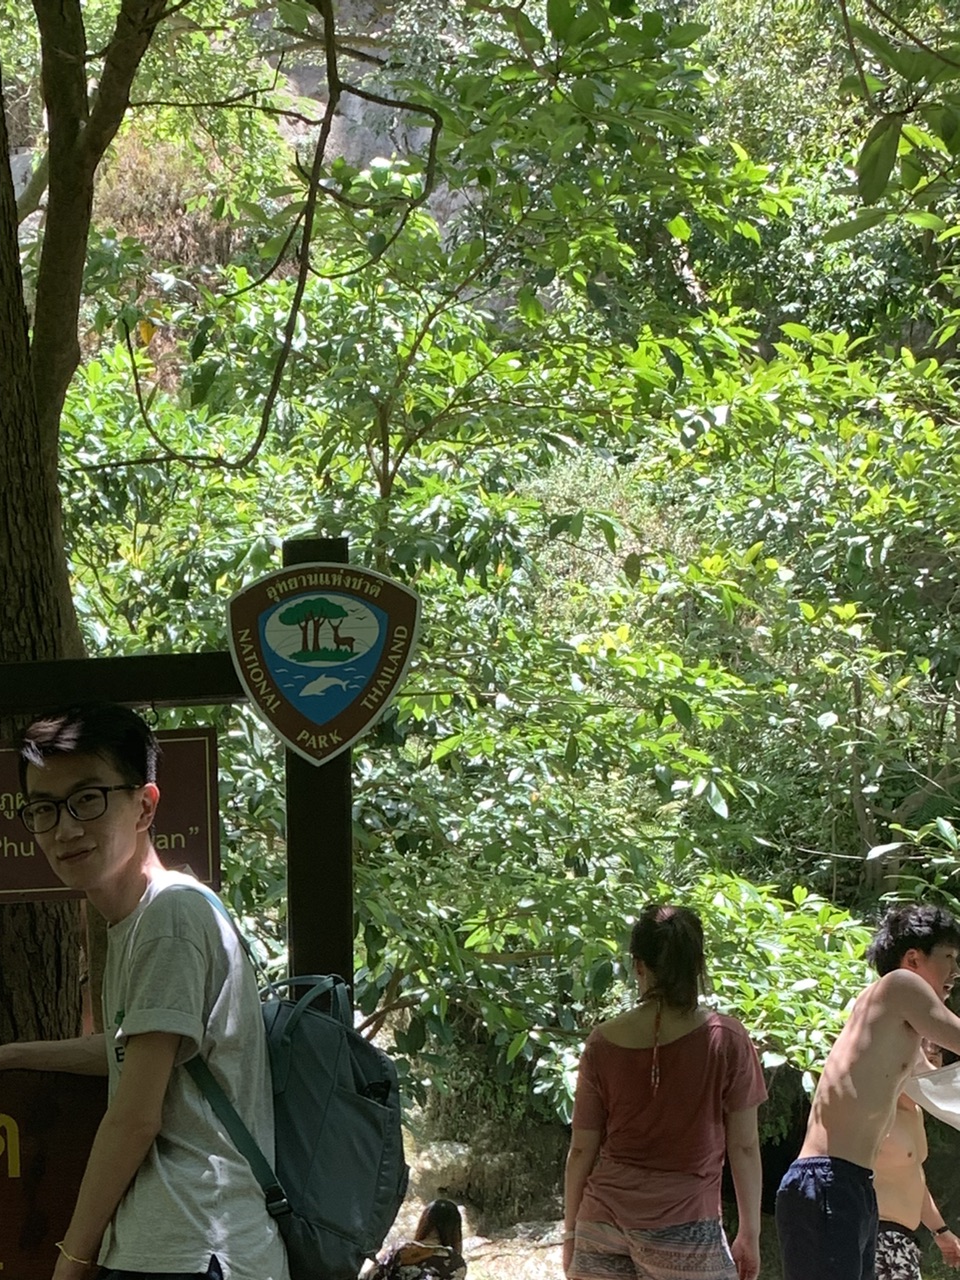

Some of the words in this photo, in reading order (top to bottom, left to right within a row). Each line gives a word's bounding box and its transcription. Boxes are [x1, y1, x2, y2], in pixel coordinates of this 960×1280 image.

[265, 569, 384, 602] อุทยานแห่งชาติ
[237, 628, 283, 714] NATIONAL
[296, 728, 343, 749] PARK
[360, 625, 408, 710] THAILAND
